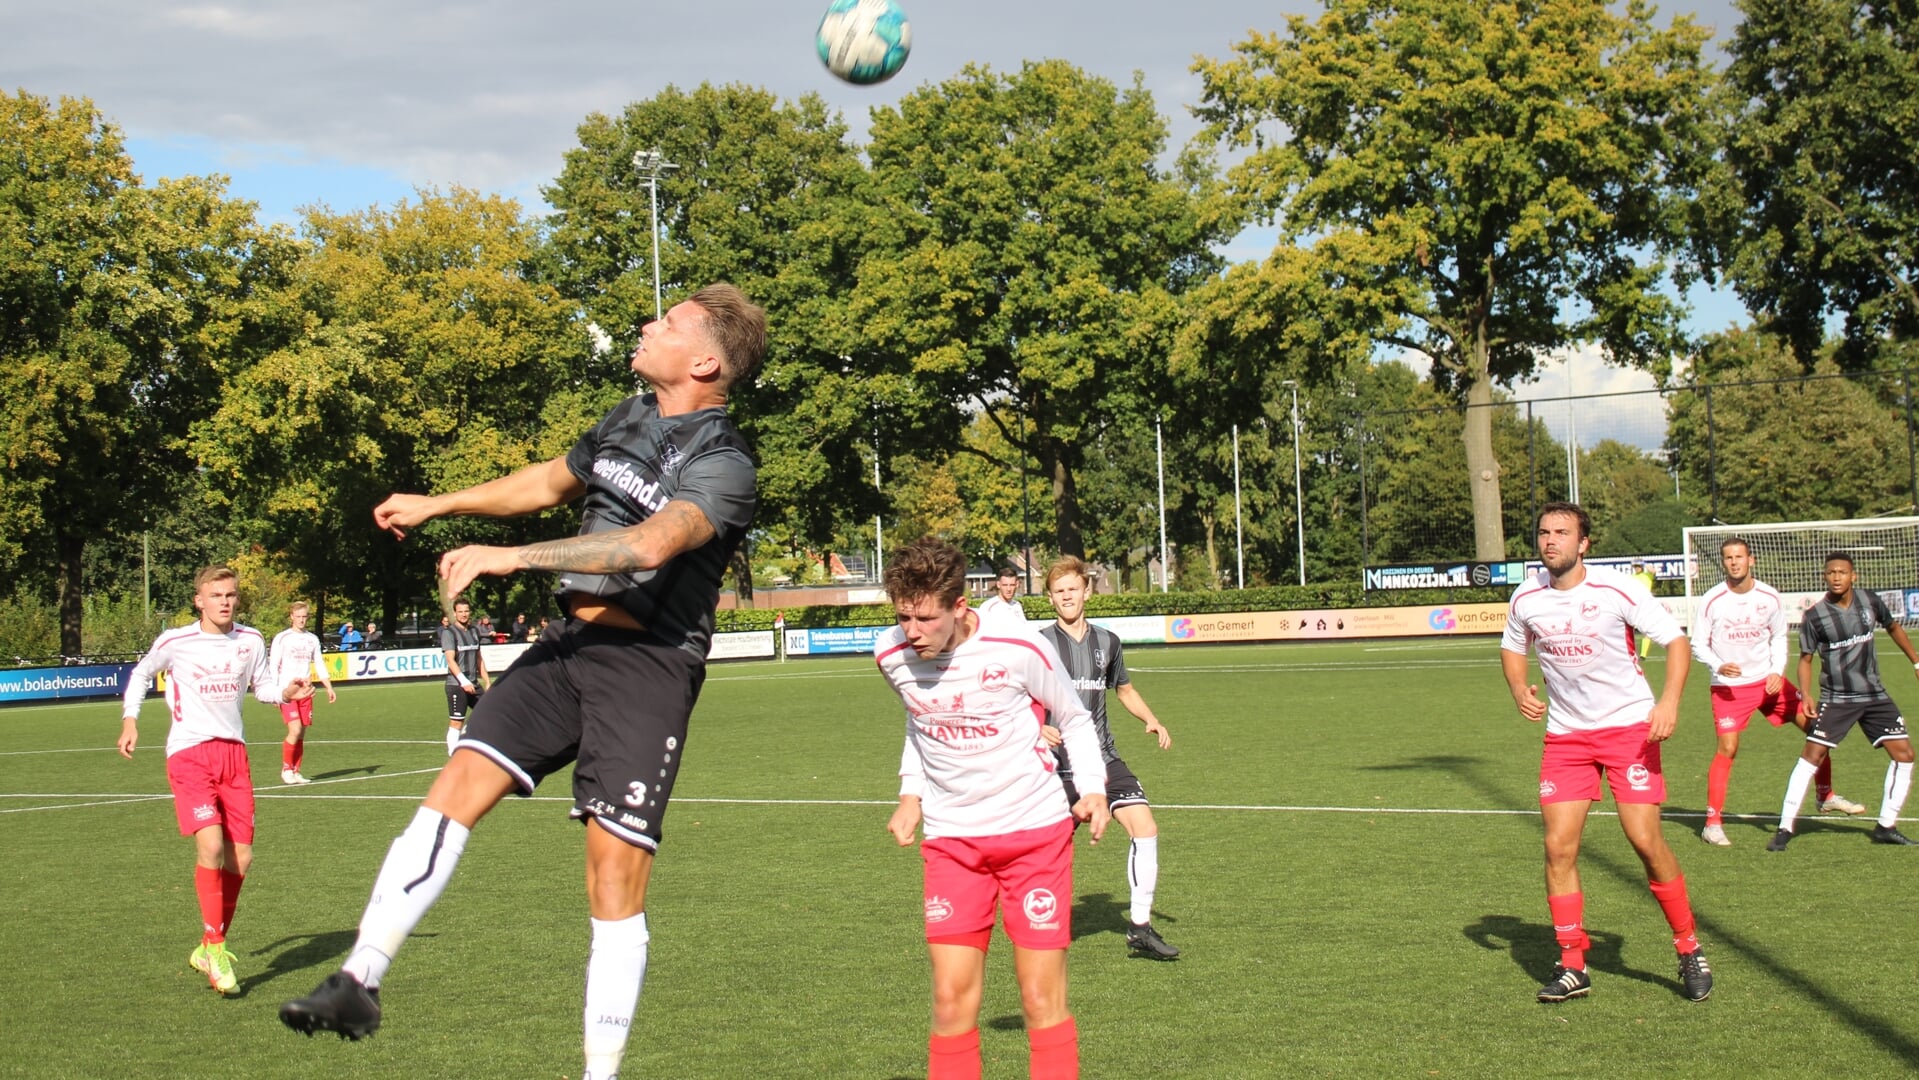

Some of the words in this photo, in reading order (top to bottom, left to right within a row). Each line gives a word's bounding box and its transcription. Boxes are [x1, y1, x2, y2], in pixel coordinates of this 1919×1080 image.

[1382, 573, 1470, 589] MNKOZIJN.NL
[1458, 614, 1478, 622] van
[1480, 611, 1507, 621] Gem
[1217, 620, 1254, 631] Gemert
[1728, 631, 1760, 640] HAVENS
[384, 654, 448, 672] CREEM
[625, 781, 647, 806] 3
[620, 813, 648, 830] JAKO
[597, 1014, 629, 1028] JAKO
